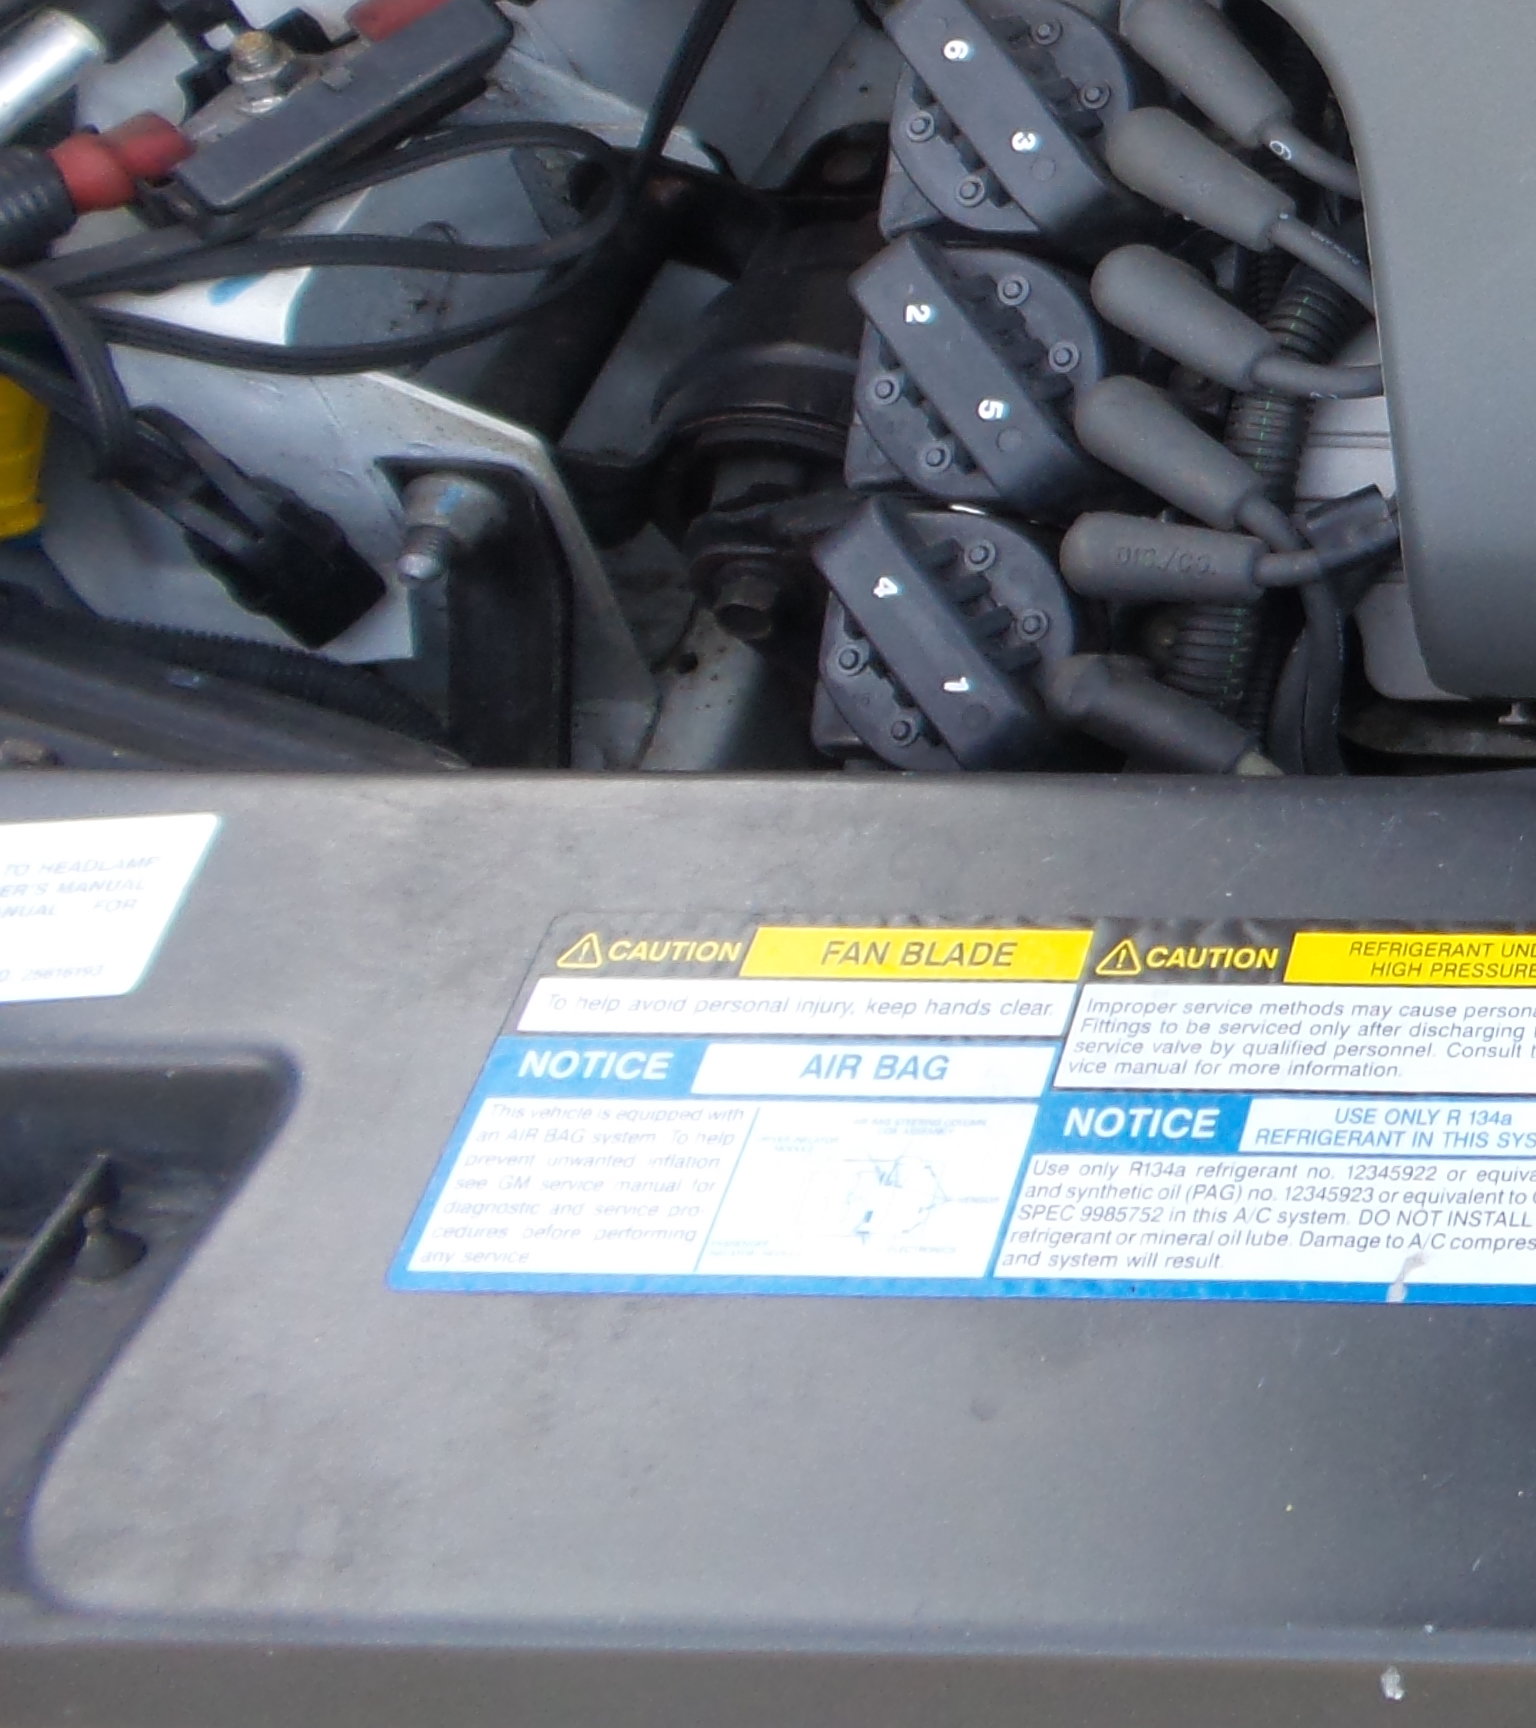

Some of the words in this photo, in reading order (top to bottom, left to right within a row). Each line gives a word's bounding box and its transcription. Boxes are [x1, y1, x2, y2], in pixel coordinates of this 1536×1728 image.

[943, 39, 969, 61] 6
[1011, 131, 1037, 152] 3
[905, 303, 932, 323] 2
[978, 399, 1005, 419] 5
[873, 576, 898, 598] 4
[943, 676, 969, 692] 1
[608, 940, 742, 962] CAUTION
[821, 940, 890, 966] FAN
[900, 941, 1018, 967] BLADE
[1146, 946, 1279, 969] CAUTION
[1349, 941, 1494, 959] REFRIGERANT
[1371, 962, 1422, 977] HIGH
[576, 995, 620, 1015] help
[630, 995, 687, 1014] avoid
[693, 996, 789, 1016] personal
[865, 998, 917, 1019] keep
[924, 998, 991, 1016] hands
[1087, 998, 1177, 1017] Improper
[1184, 999, 1253, 1015] service
[1260, 1000, 1344, 1016] methods
[1351, 1004, 1392, 1020] may
[1399, 1004, 1457, 1018] cause
[1080, 1017, 1151, 1038] Fittings
[1159, 1019, 1178, 1034] to
[1186, 1019, 1211, 1035] be
[1218, 1020, 1302, 1035] serviced
[1310, 1021, 1350, 1039] only
[1358, 1022, 1402, 1037] after
[1409, 1023, 1525, 1042] discharging
[1073, 1039, 1143, 1054] service
[1152, 1039, 1202, 1055] valve
[1210, 1040, 1234, 1059] by
[1242, 1040, 1326, 1060] qualified
[1446, 1042, 1522, 1059] Consult
[519, 1050, 674, 1080] NOTICE
[799, 1053, 862, 1080] AIR
[873, 1054, 950, 1081] BAG
[1068, 1059, 1107, 1074] vice
[1114, 1060, 1187, 1075] manual
[1195, 1060, 1219, 1075] for
[1230, 1061, 1280, 1076] more
[1288, 1061, 1402, 1077] information.
[1063, 1107, 1220, 1139] NOTICE
[1335, 1107, 1378, 1125] USE
[1384, 1108, 1440, 1126] ONLY
[1446, 1109, 1461, 1126] R
[1469, 1110, 1513, 1126] 134a
[1255, 1128, 1406, 1147] REFRIGERANT
[1412, 1130, 1434, 1148] IN
[1442, 1131, 1489, 1148] THIS
[1017, 1204, 1076, 1222] SPEC
[1080, 1205, 1164, 1223] 9985752
[1169, 1206, 1186, 1223] in
[1192, 1206, 1227, 1224] this
[1233, 1206, 1271, 1225] A/C
[1358, 1208, 1390, 1226] DO
[1396, 1209, 1442, 1227] NOT
[1447, 1210, 1532, 1228] INSTALL
